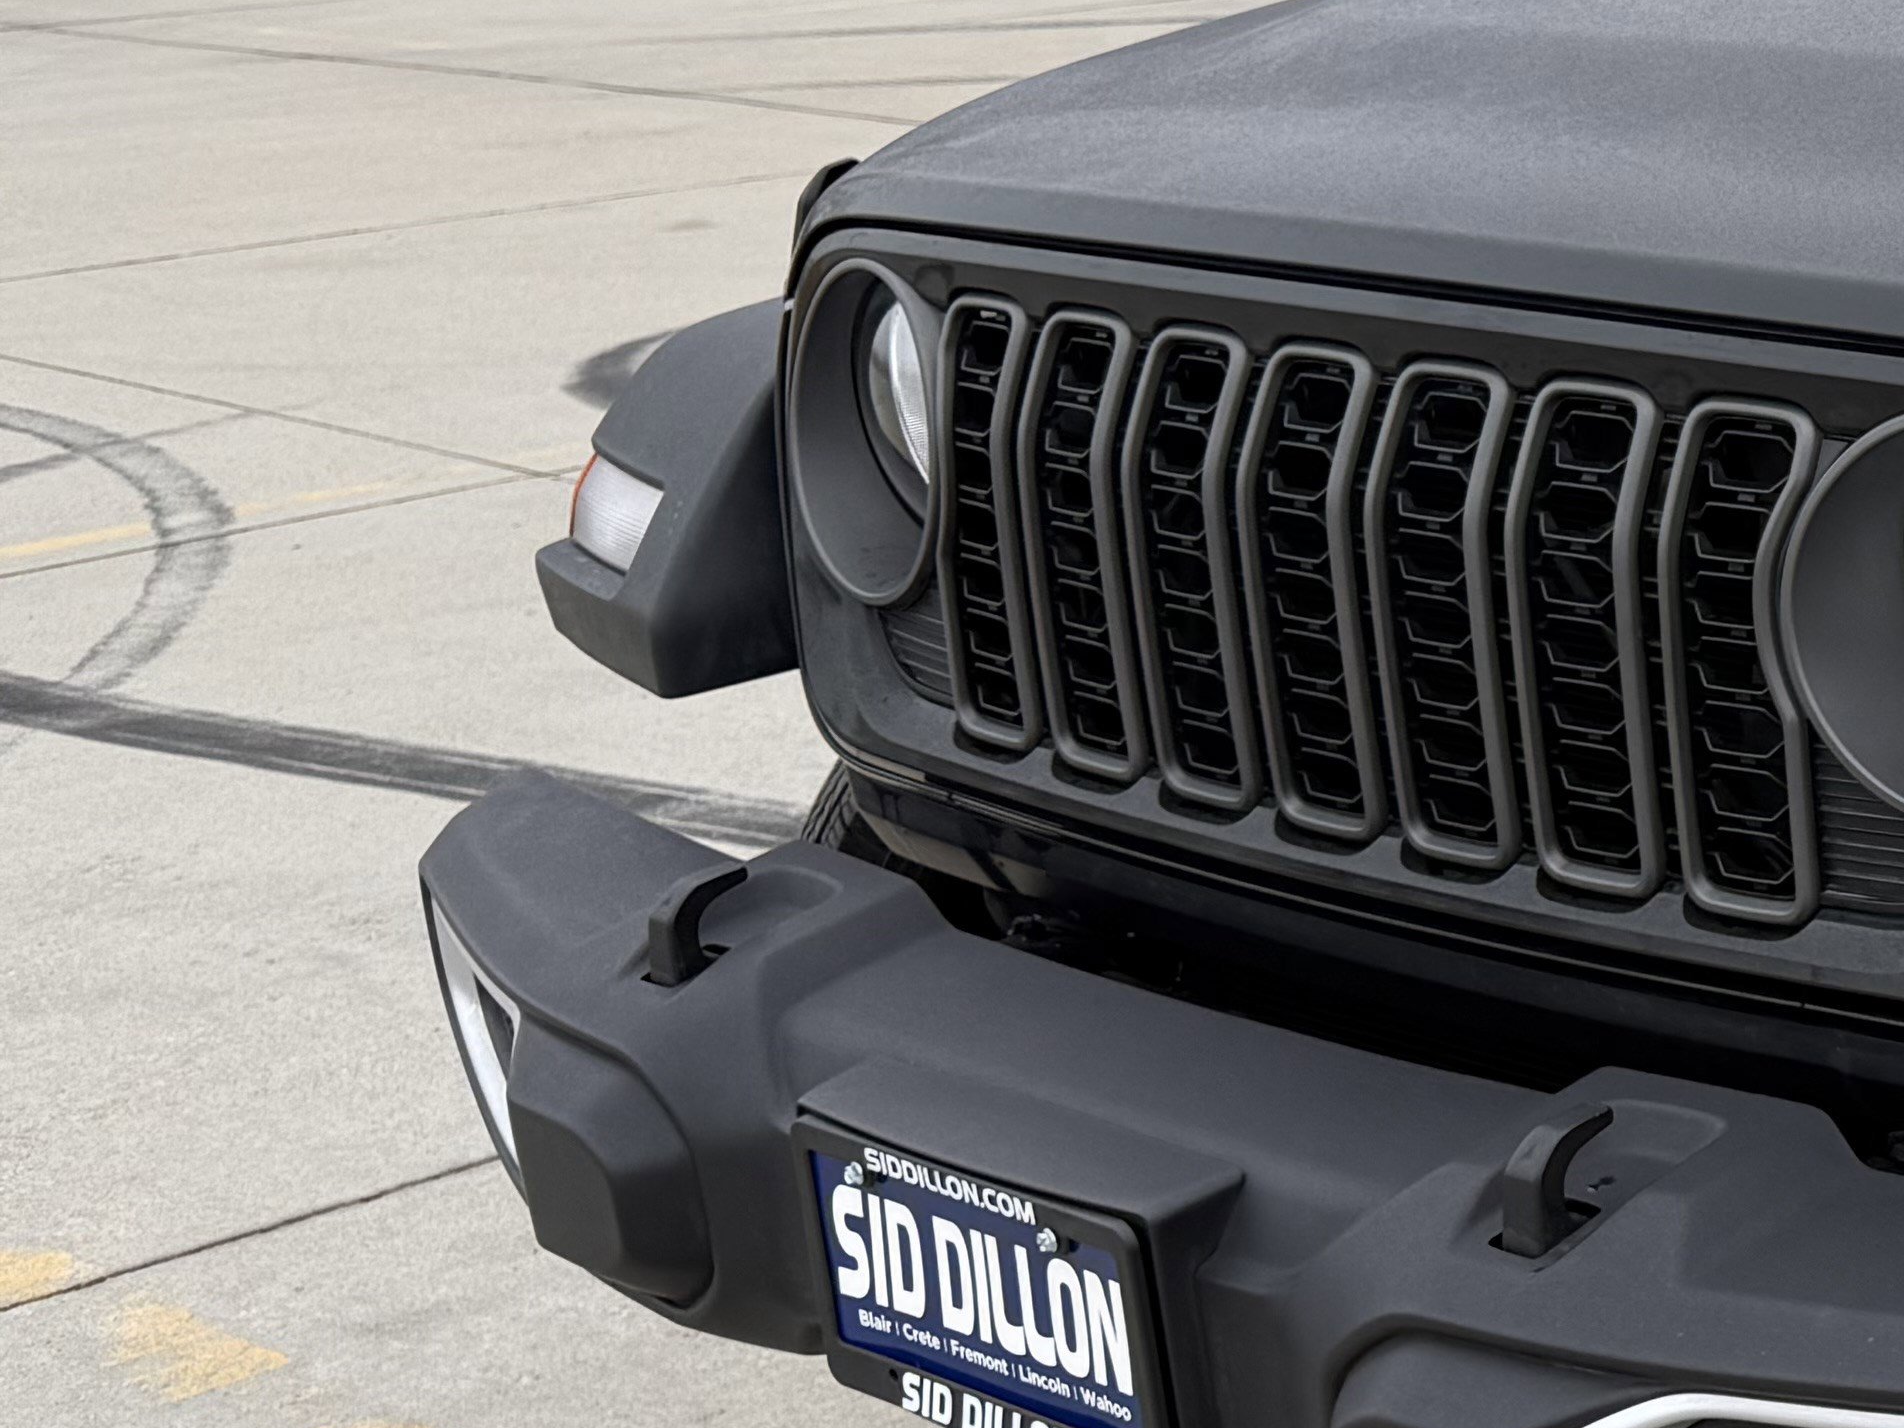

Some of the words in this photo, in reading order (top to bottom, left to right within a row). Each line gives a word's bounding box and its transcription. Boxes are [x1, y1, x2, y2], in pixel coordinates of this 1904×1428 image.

[863, 1146, 1036, 1226] SIDDILLON.COM
[831, 1183, 927, 1320] SID
[931, 1214, 1135, 1398] DILLON
[857, 1307, 893, 1335] Blair
[902, 1321, 942, 1352] Crete
[949, 1337, 1010, 1378] Fremont
[1018, 1363, 1071, 1400] Lincoln
[1079, 1384, 1132, 1423] Wahoo
[901, 1371, 953, 1426] SID
